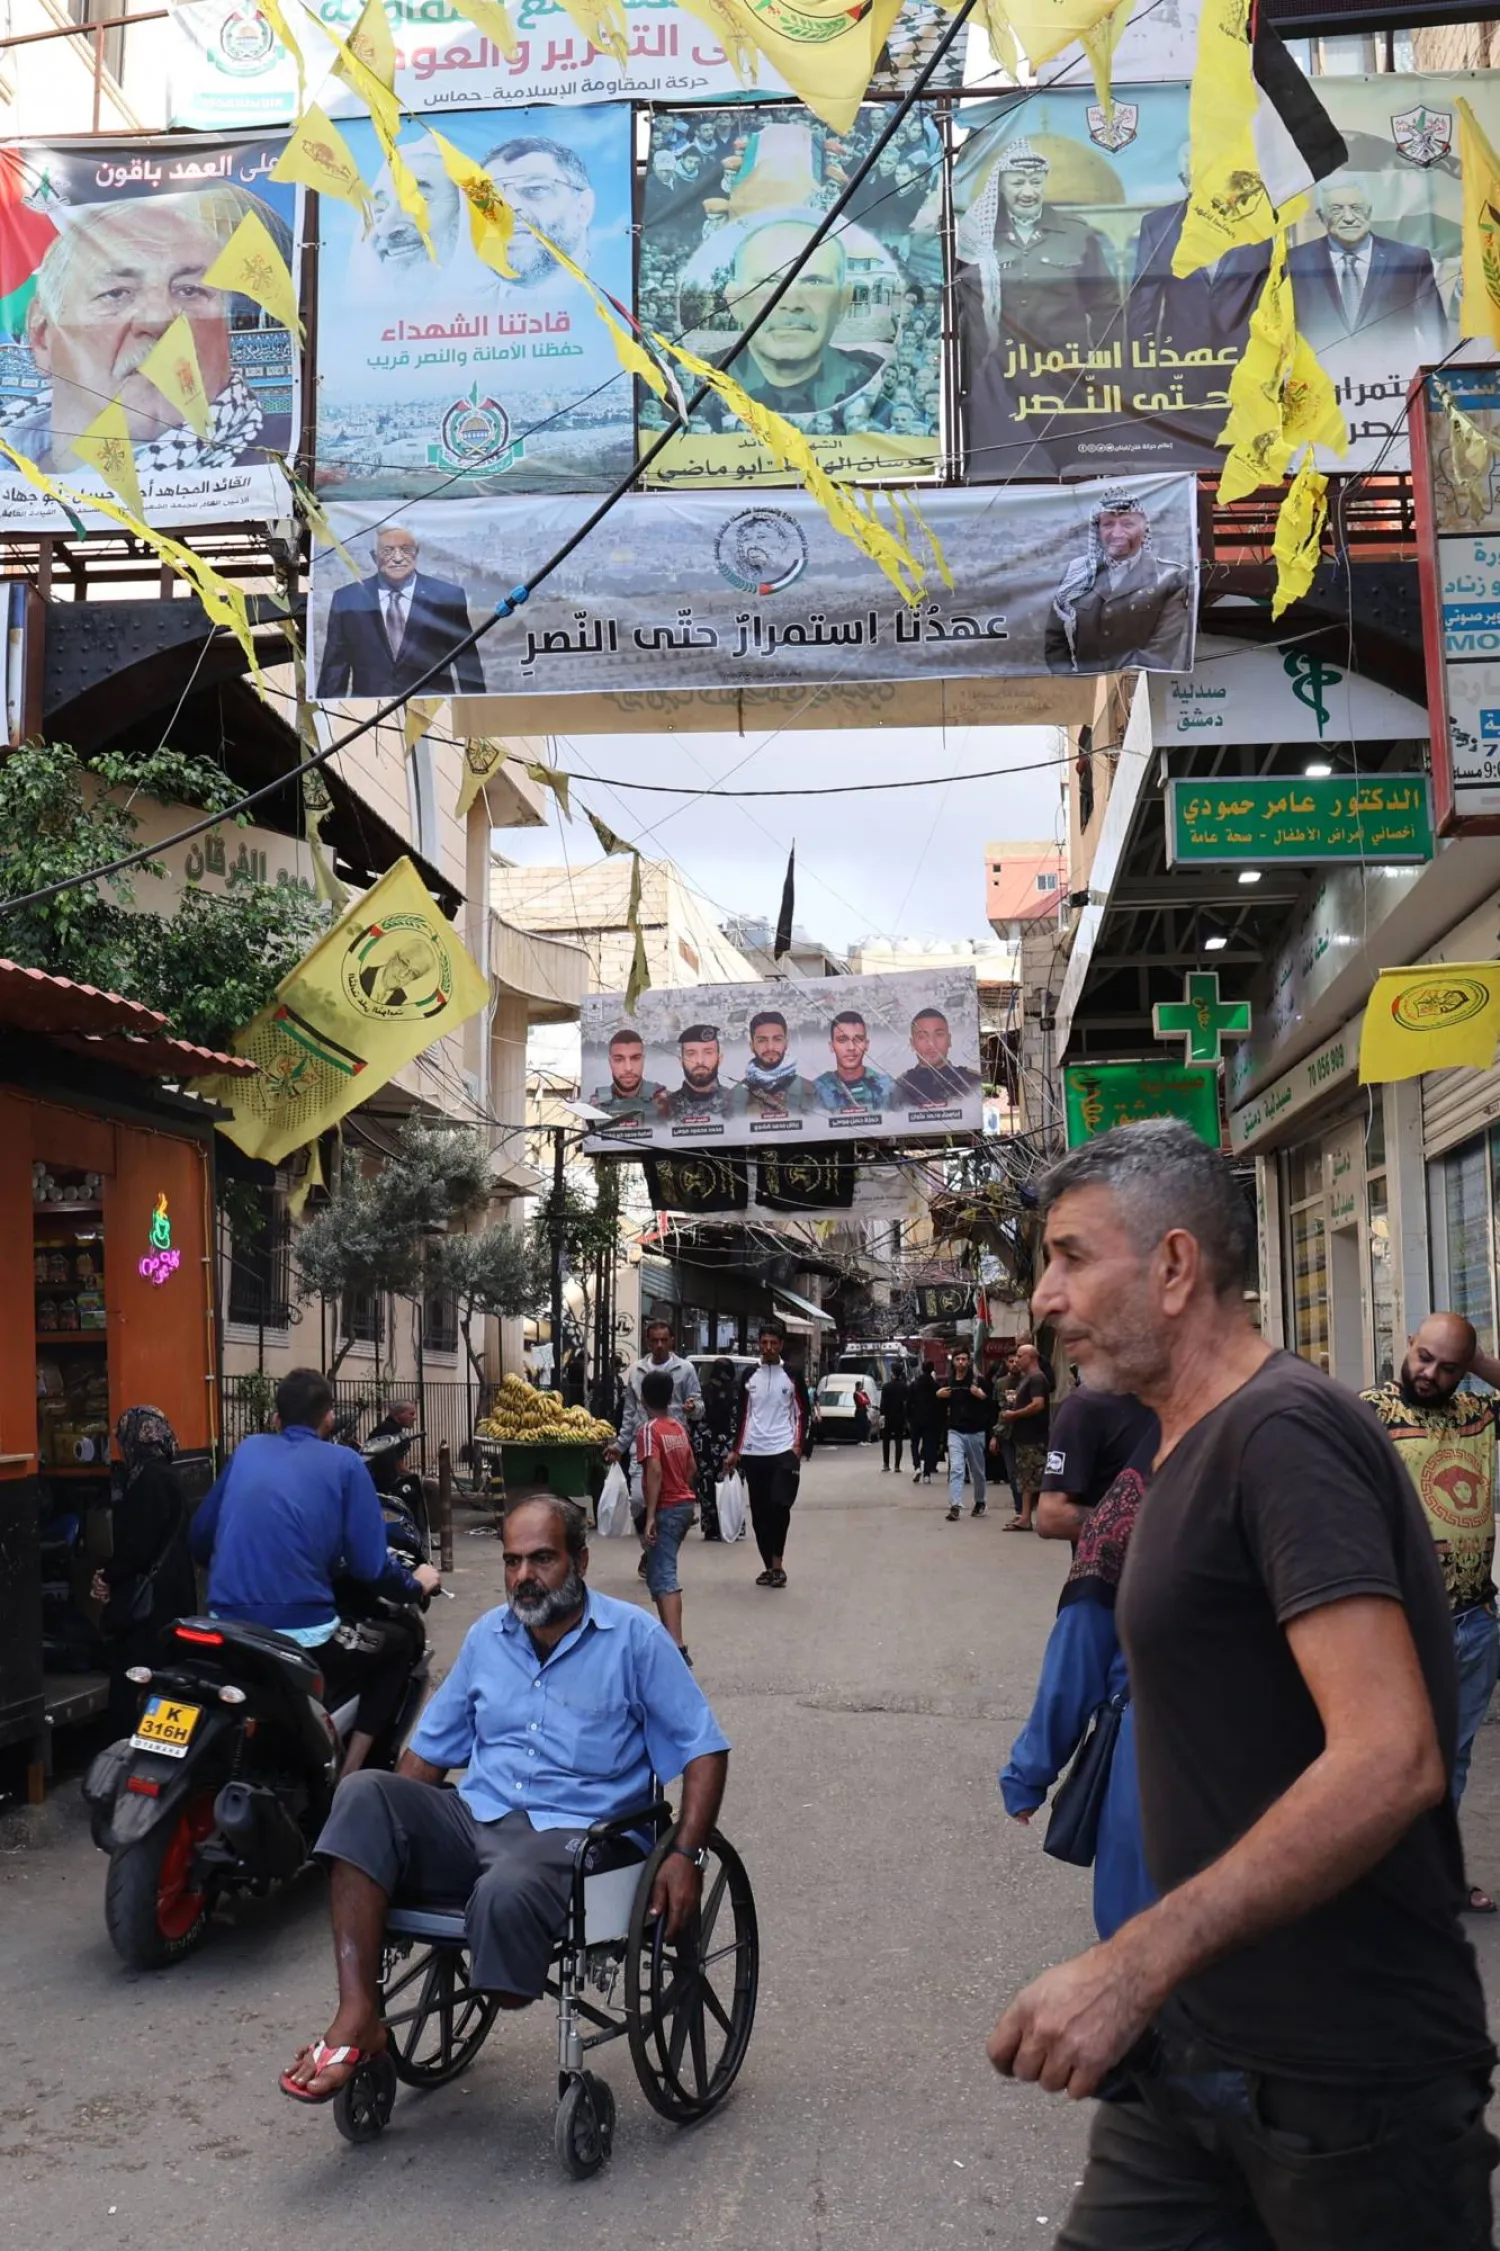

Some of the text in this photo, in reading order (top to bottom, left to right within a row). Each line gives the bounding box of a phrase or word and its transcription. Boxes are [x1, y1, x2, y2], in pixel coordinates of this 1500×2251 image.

[581, 77, 662, 94] المقاومة
[666, 75, 709, 90] حركة
[95, 158, 162, 188] باقون
[169, 154, 233, 180] العهد
[380, 310, 571, 342] قادتنا الشهداء
[366, 341, 584, 370] حفظنا الأمانة والنصر قريب
[155, 480, 210, 499] المجاهد
[212, 475, 252, 493] القائد
[1176, 708, 1224, 732] دمشق
[1183, 787, 1421, 824] الدكتور عامر حمودي
[1190, 828, 1218, 844] عامة
[1226, 827, 1252, 843] صحة
[166, 1707, 183, 1722] K
[142, 1720, 188, 1741] 316H
